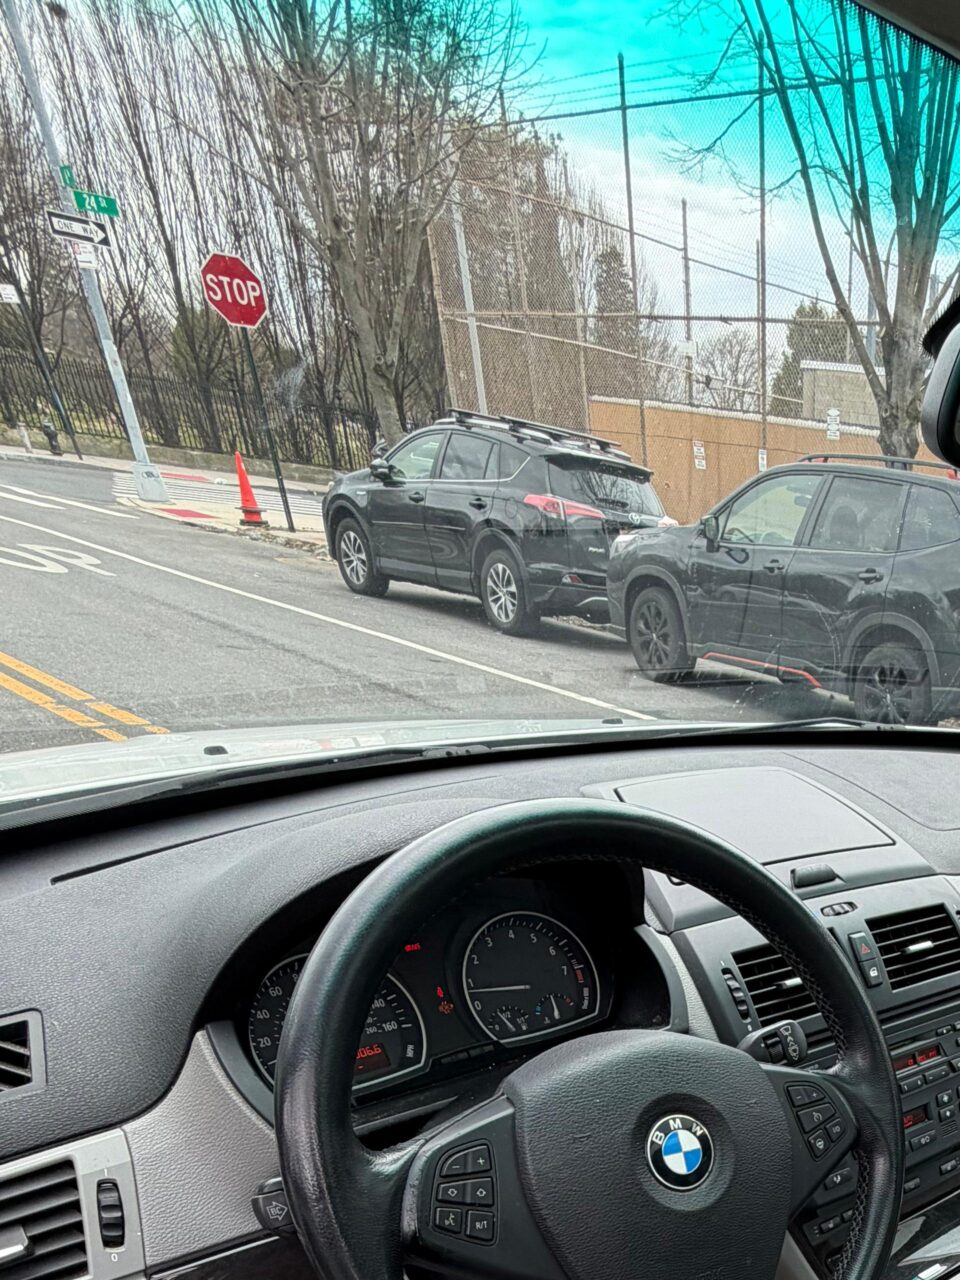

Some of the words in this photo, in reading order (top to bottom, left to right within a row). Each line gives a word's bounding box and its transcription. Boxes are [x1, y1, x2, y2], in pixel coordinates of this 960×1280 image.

[83, 194, 97, 211] 24
[58, 220, 75, 232] ONE
[205, 273, 260, 307] STOP
[508, 930, 515, 939] 4
[530, 933, 537, 943] 5
[486, 937, 493, 947] 3
[549, 946, 556, 956] 6
[471, 955, 479, 964] 2
[561, 966, 568, 975] 7
[269, 985, 283, 997] 60
[474, 1001, 481, 1010] 0
[256, 1009, 270, 1020] 40
[382, 1021, 398, 1032] 160
[257, 1036, 272, 1048] 20
[652, 1118, 704, 1145] BMW
[475, 1220, 488, 1230] R/T
